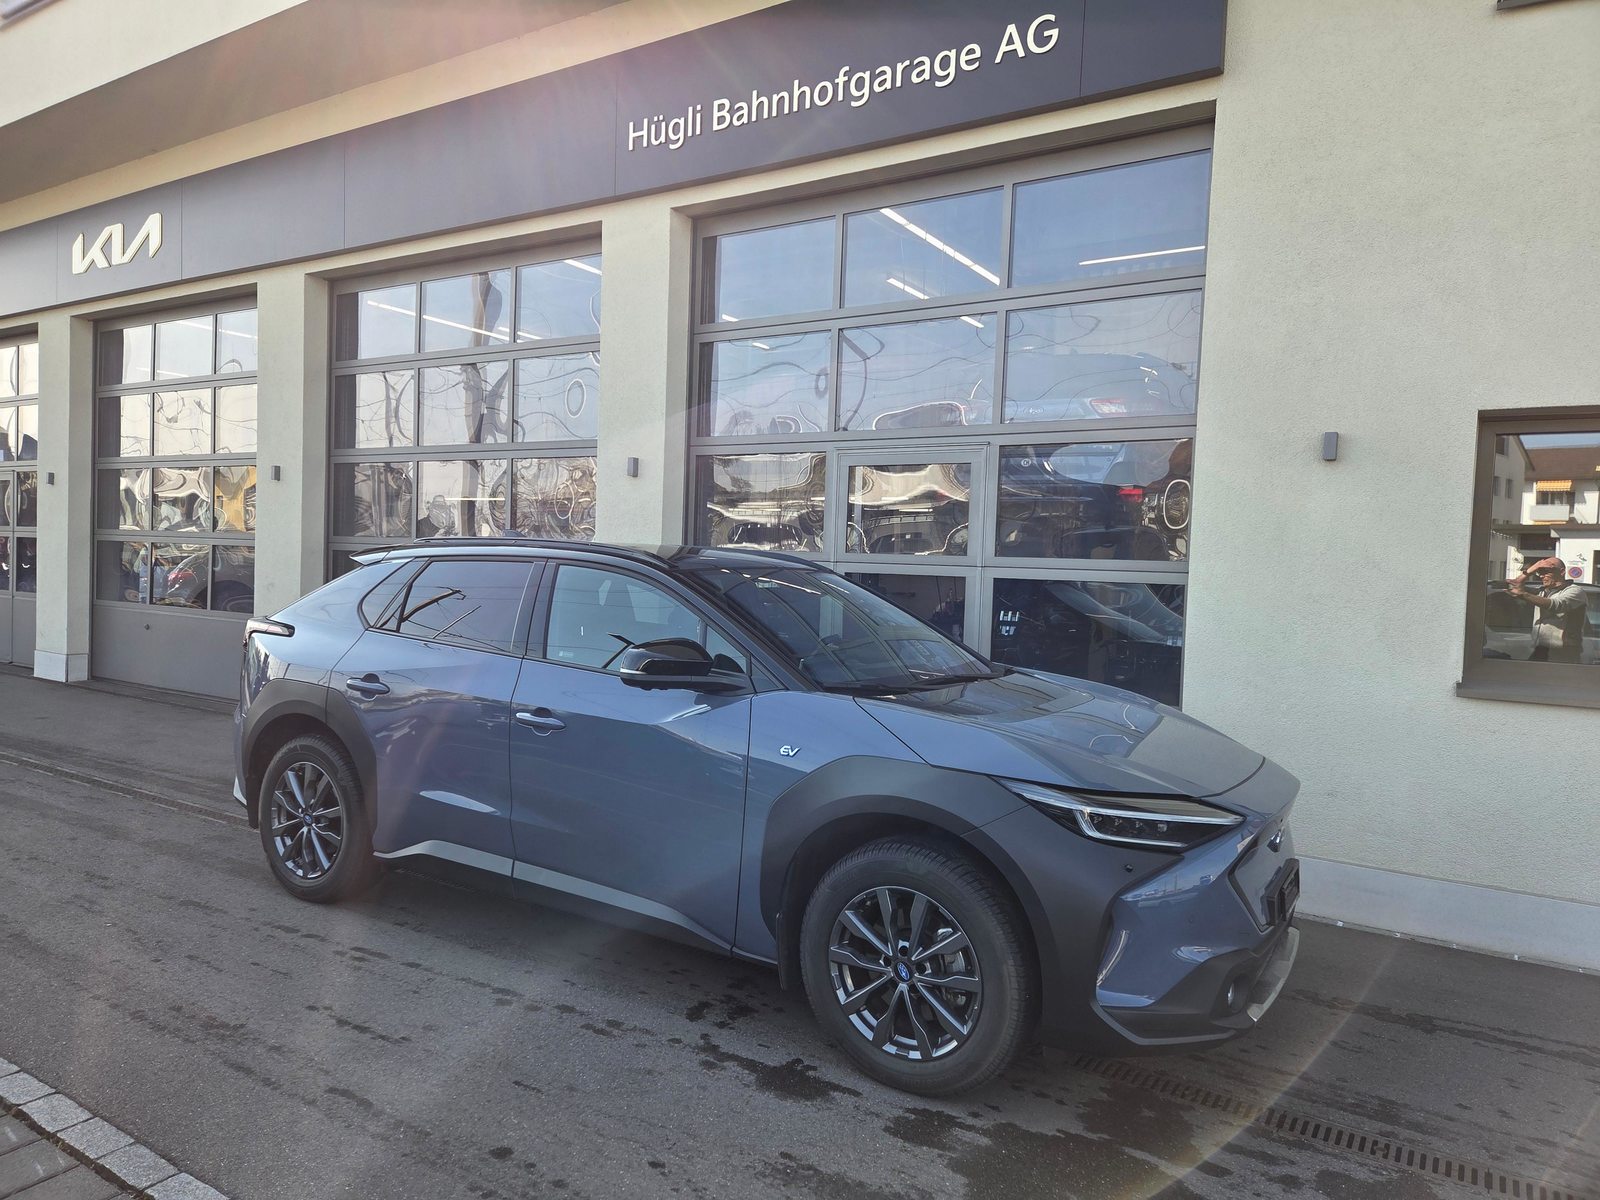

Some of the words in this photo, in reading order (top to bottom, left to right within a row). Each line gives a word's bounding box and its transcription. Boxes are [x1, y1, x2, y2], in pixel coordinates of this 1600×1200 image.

[627, 103, 703, 151] Hügli
[712, 42, 982, 132] Bahnhofgarage
[994, 13, 1060, 64] AG
[71, 212, 163, 275] KIA
[780, 745, 801, 757] EV
